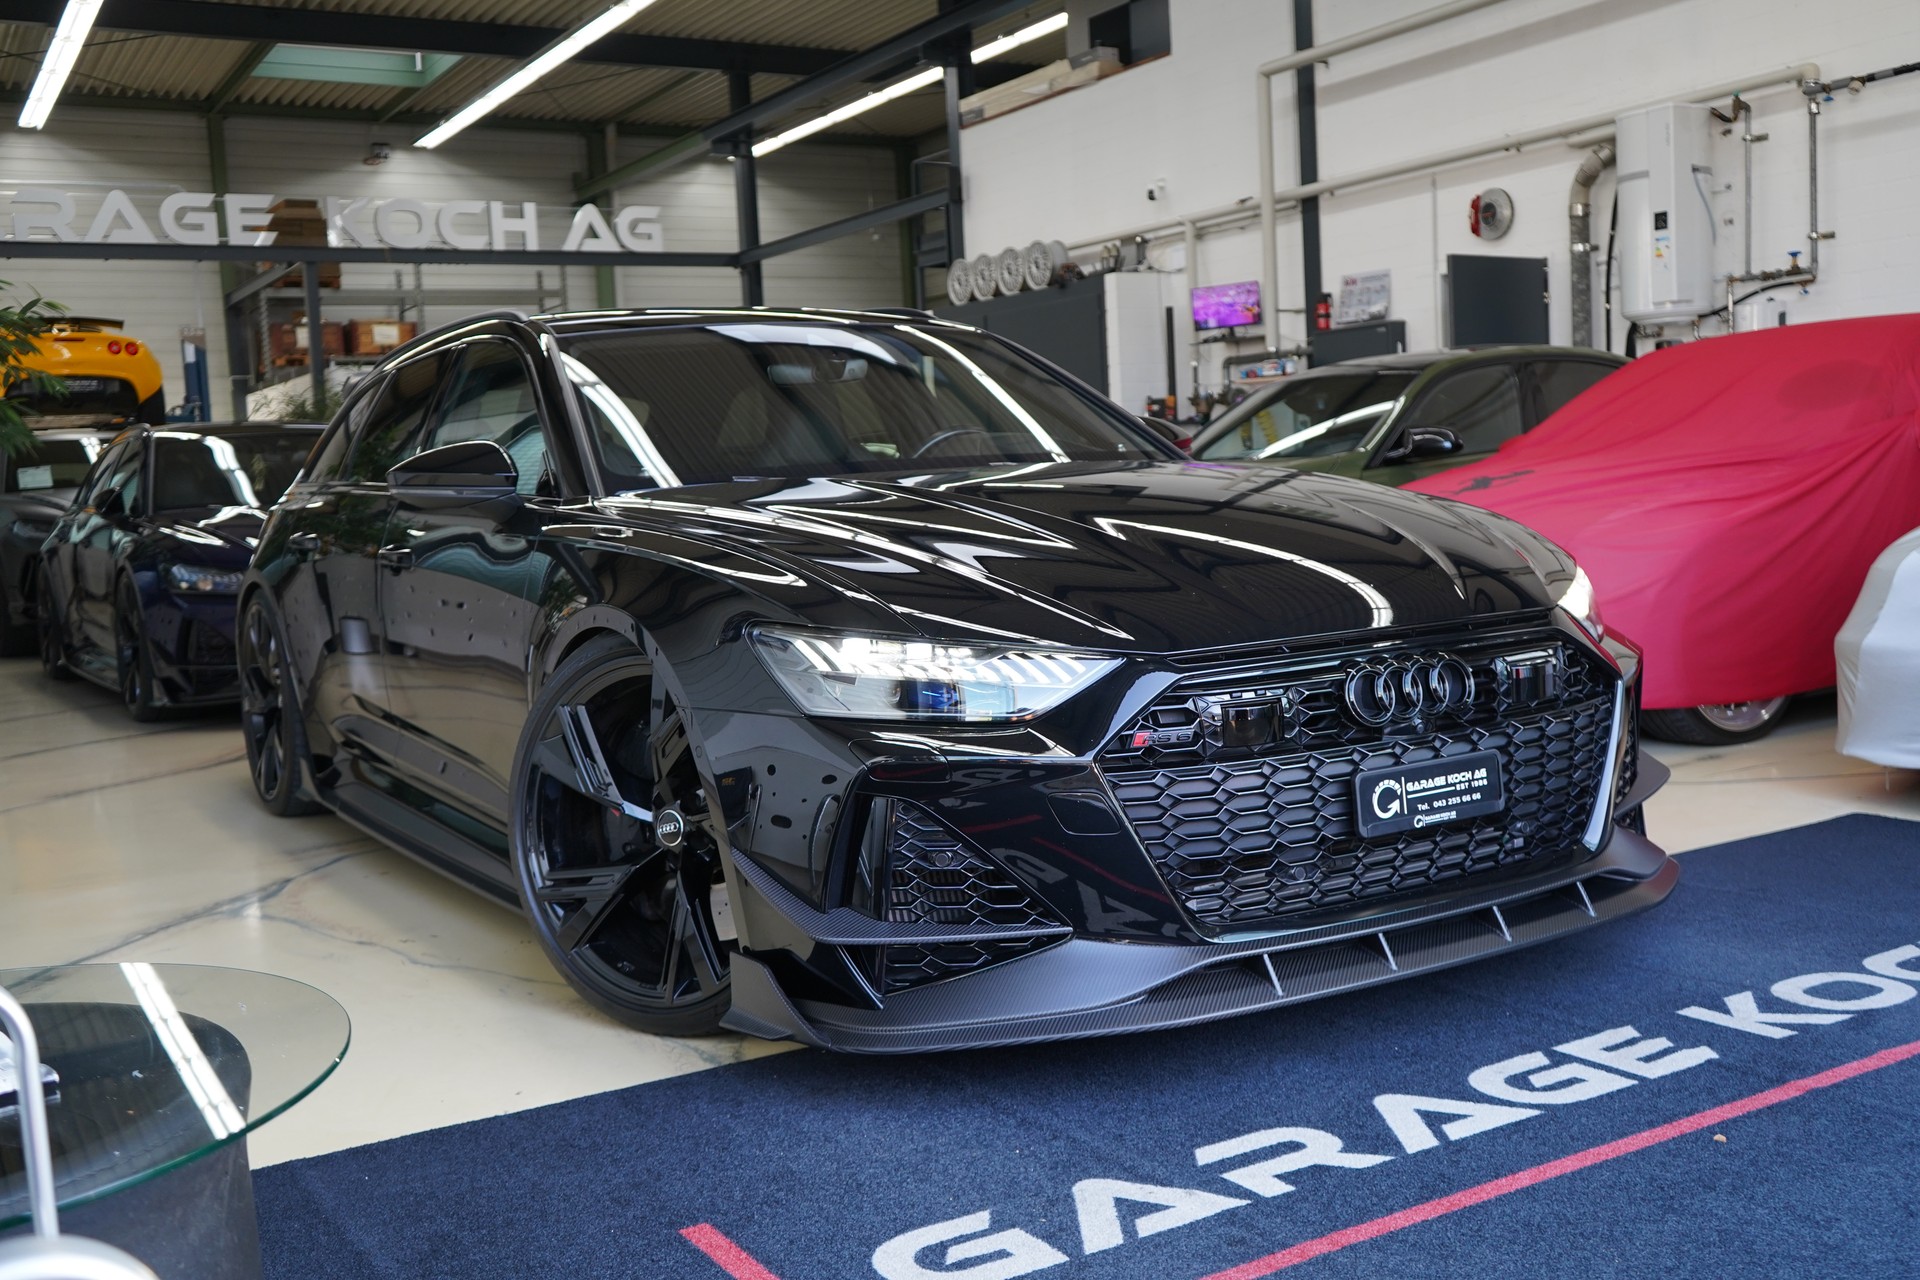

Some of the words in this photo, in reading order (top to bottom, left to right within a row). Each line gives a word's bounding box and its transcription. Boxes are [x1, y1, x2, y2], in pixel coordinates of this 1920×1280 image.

[0, 188, 279, 246] RAGE
[326, 196, 539, 251] KOCH
[561, 202, 664, 252] AG
[1406, 776, 1446, 792] GARAGE
[1447, 771, 1472, 784] KOCH
[1474, 768, 1487, 779] AG
[1456, 782, 1468, 791] EST
[1417, 802, 1430, 811] Tel.
[1433, 799, 1447, 808] 043
[1448, 796, 1461, 805] 255
[1462, 794, 1471, 802] 66
[1472, 792, 1481, 800] 66
[871, 1025, 1720, 1280] GARAGE
